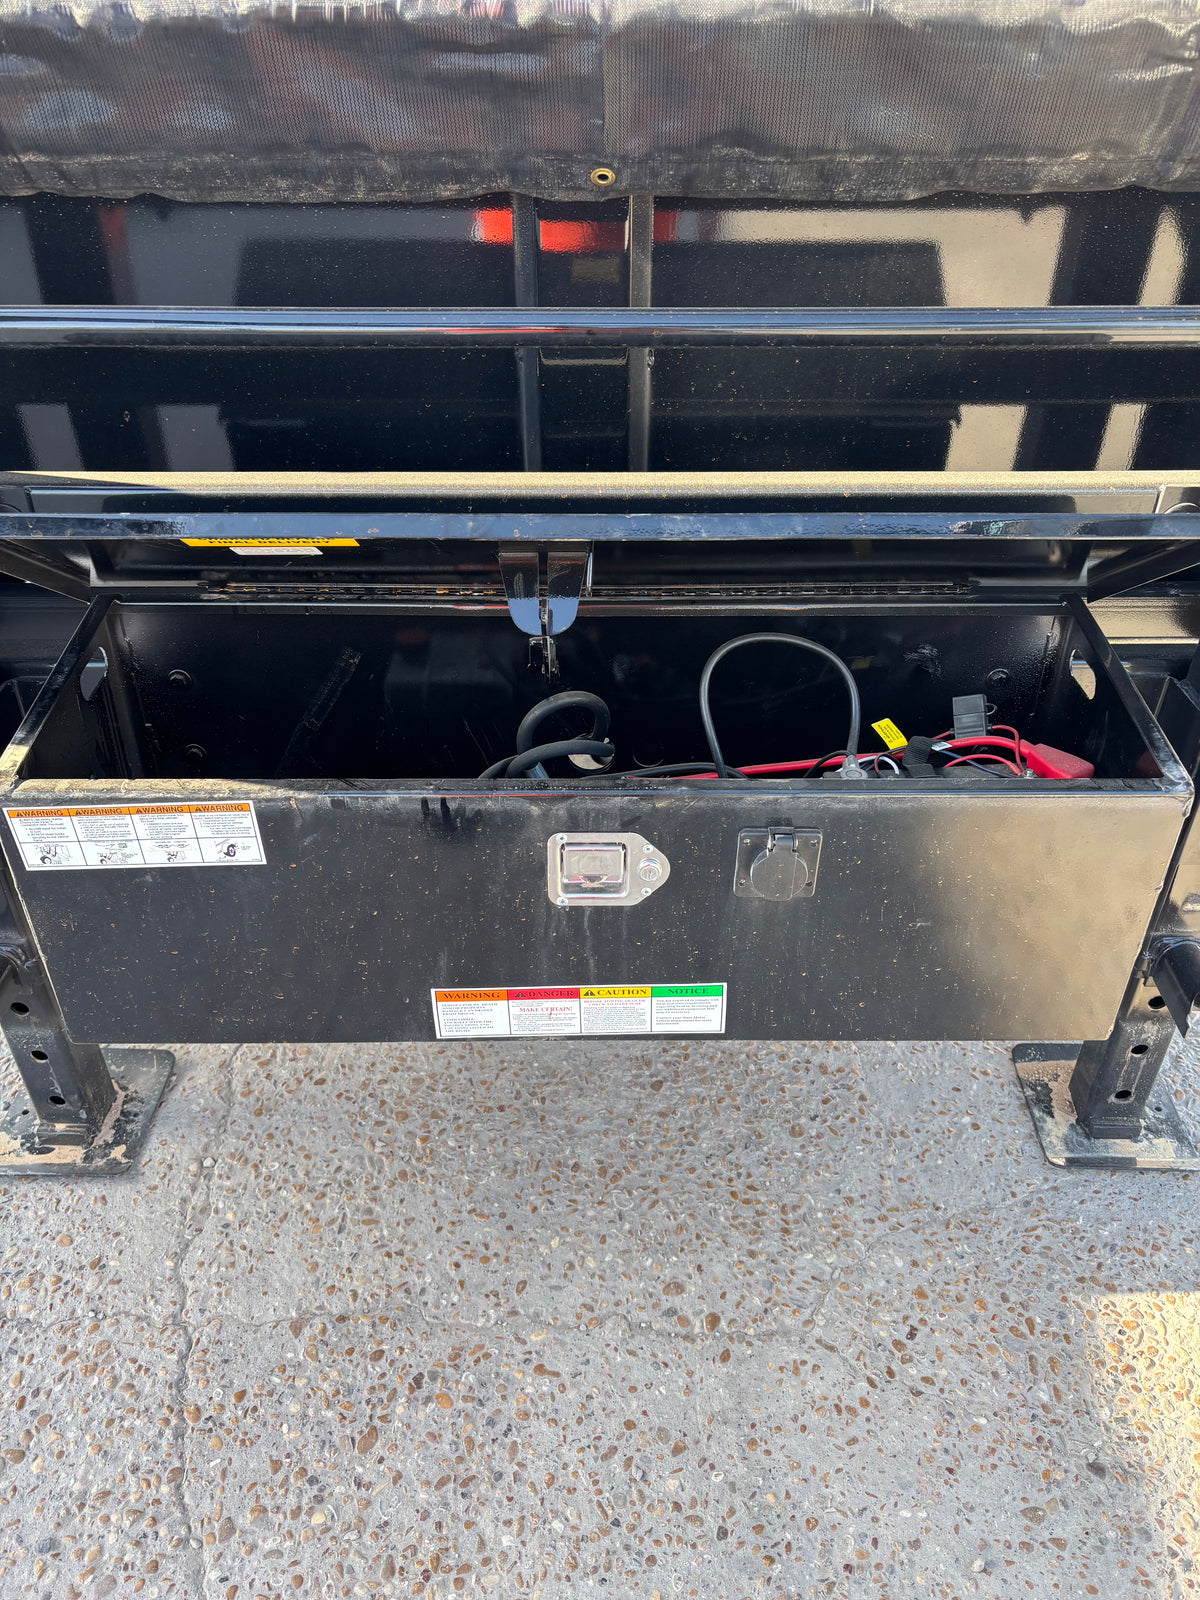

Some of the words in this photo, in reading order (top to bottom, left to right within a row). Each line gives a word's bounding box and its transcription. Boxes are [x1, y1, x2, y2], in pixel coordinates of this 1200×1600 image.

[81, 808, 123, 816] WARNING
[142, 806, 184, 814] WARNING
[201, 804, 244, 812] WARNING
[22, 809, 63, 817] WARNING
